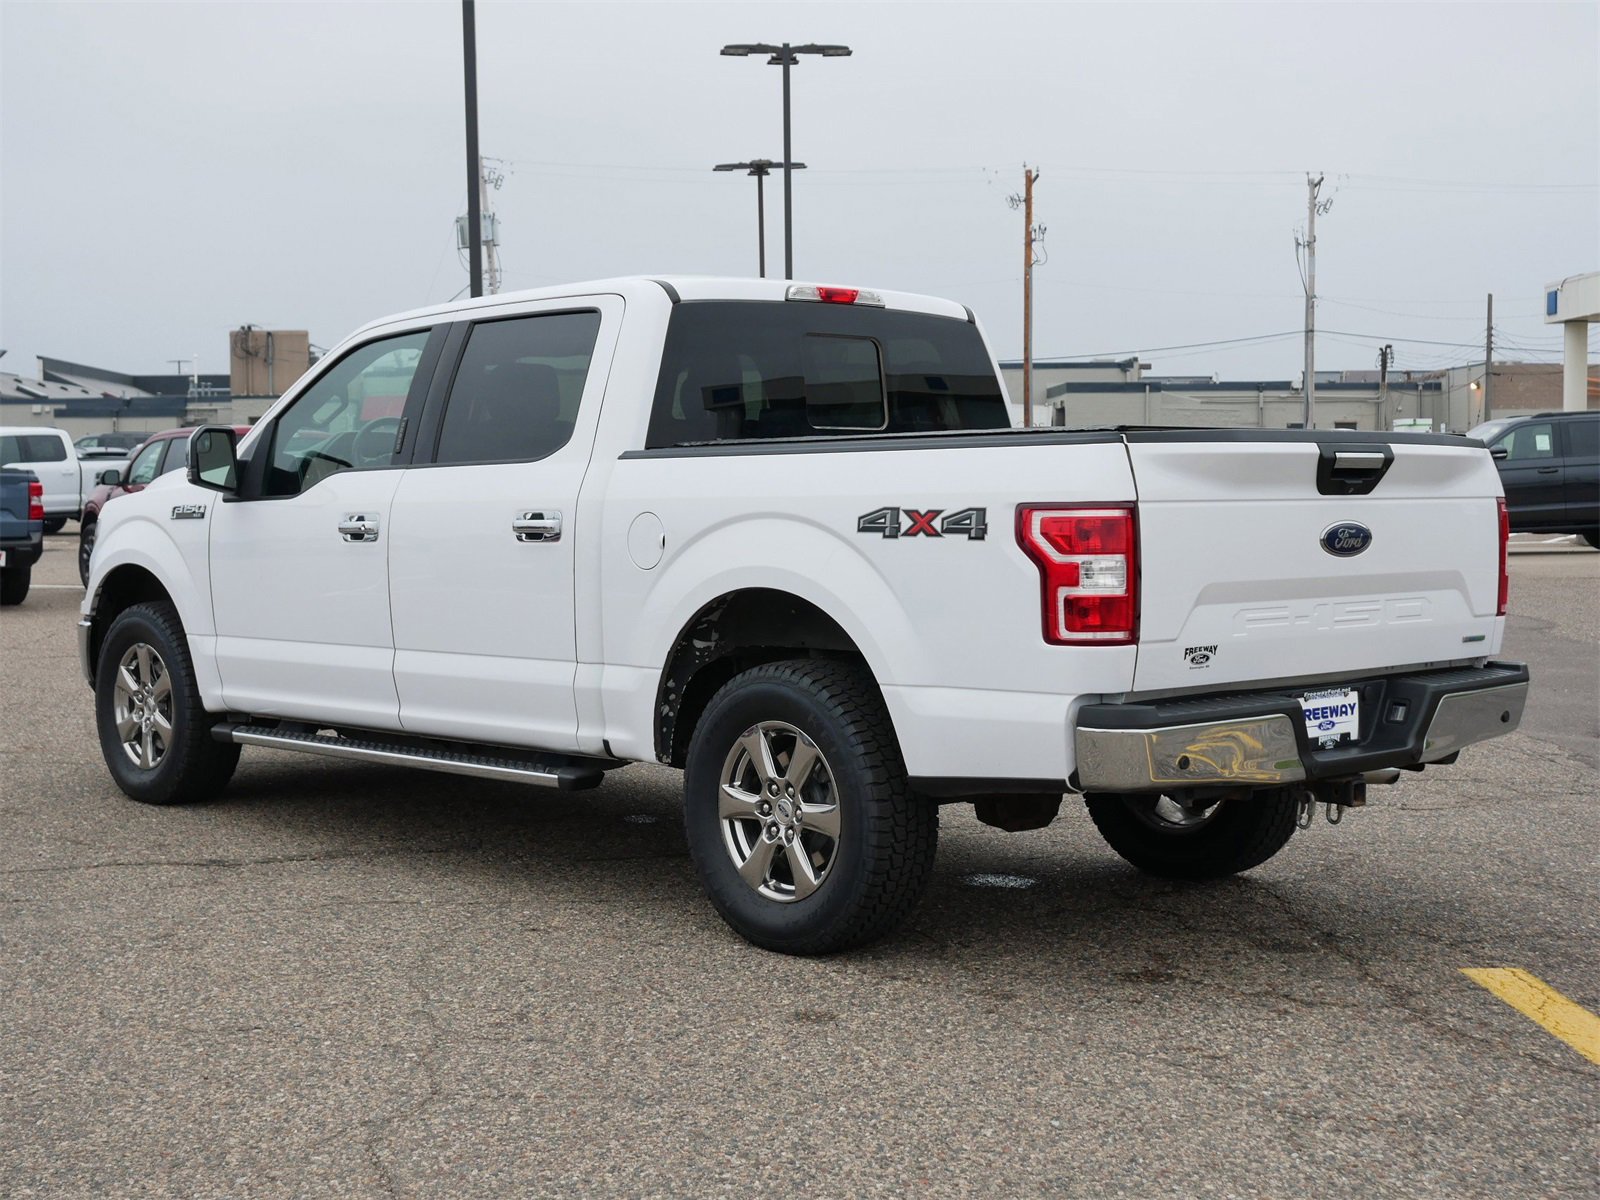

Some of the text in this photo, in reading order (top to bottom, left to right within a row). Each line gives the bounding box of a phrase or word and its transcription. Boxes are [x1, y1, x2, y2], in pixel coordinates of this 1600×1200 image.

[1334, 528, 1364, 549] Ford
[1232, 596, 1433, 637] F-150
[1184, 644, 1218, 660] FREEWAY
[1303, 703, 1356, 721] REEWAY
